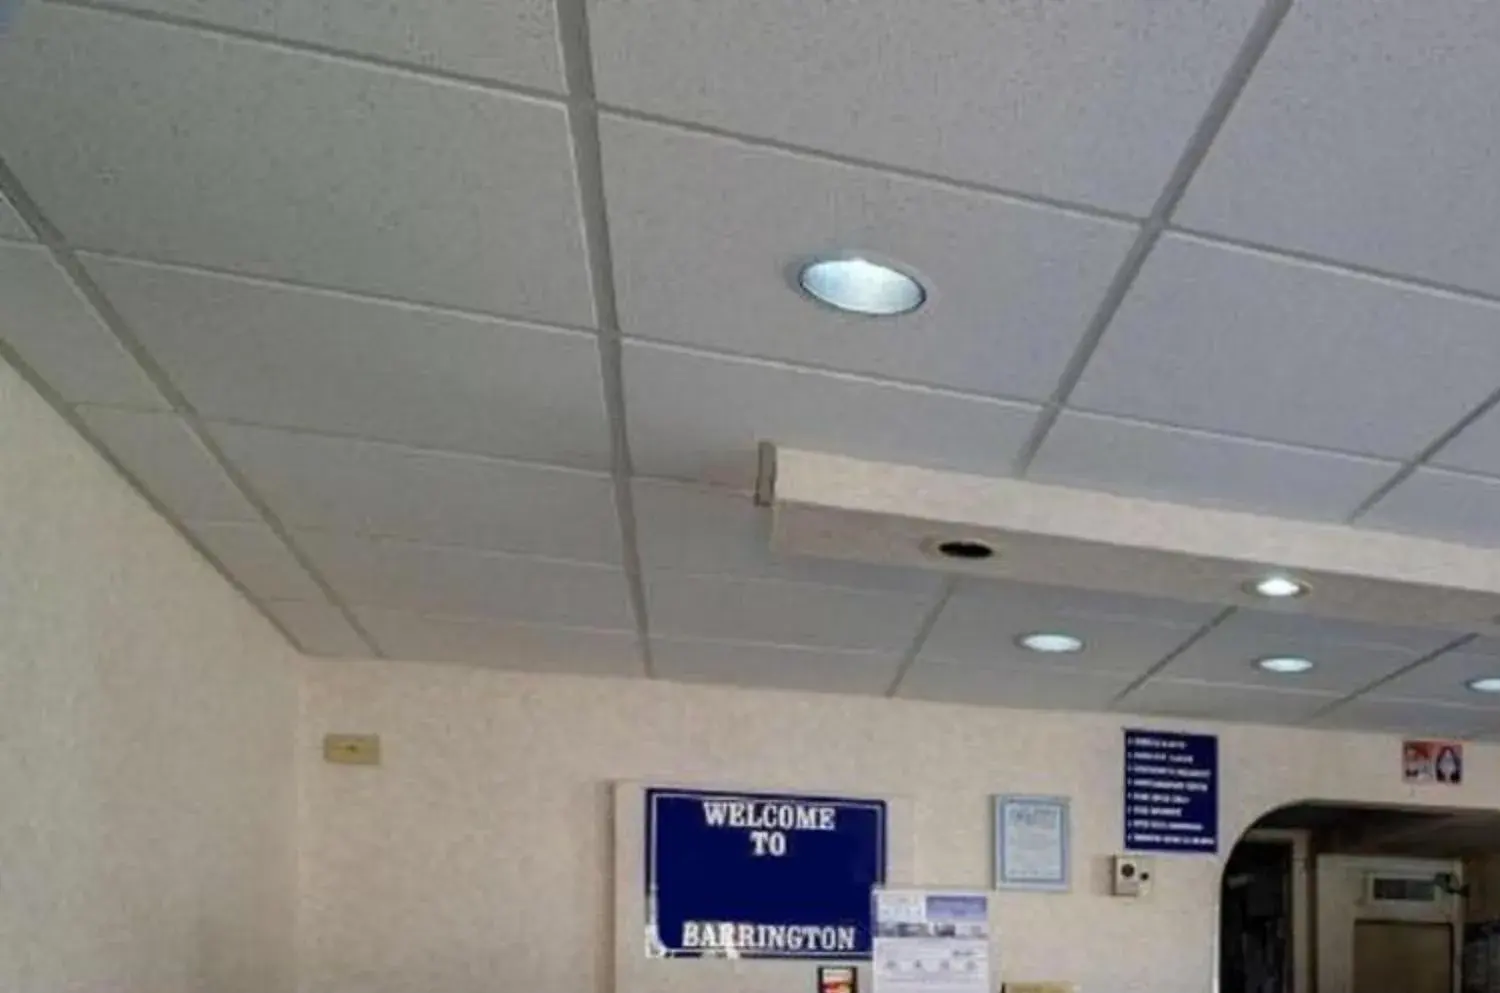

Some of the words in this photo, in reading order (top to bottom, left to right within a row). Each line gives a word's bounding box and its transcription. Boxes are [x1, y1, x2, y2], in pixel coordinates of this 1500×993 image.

[703, 801, 836, 831] WELCOME
[751, 831, 786, 856] TO
[682, 920, 855, 950] BARRINGTON
